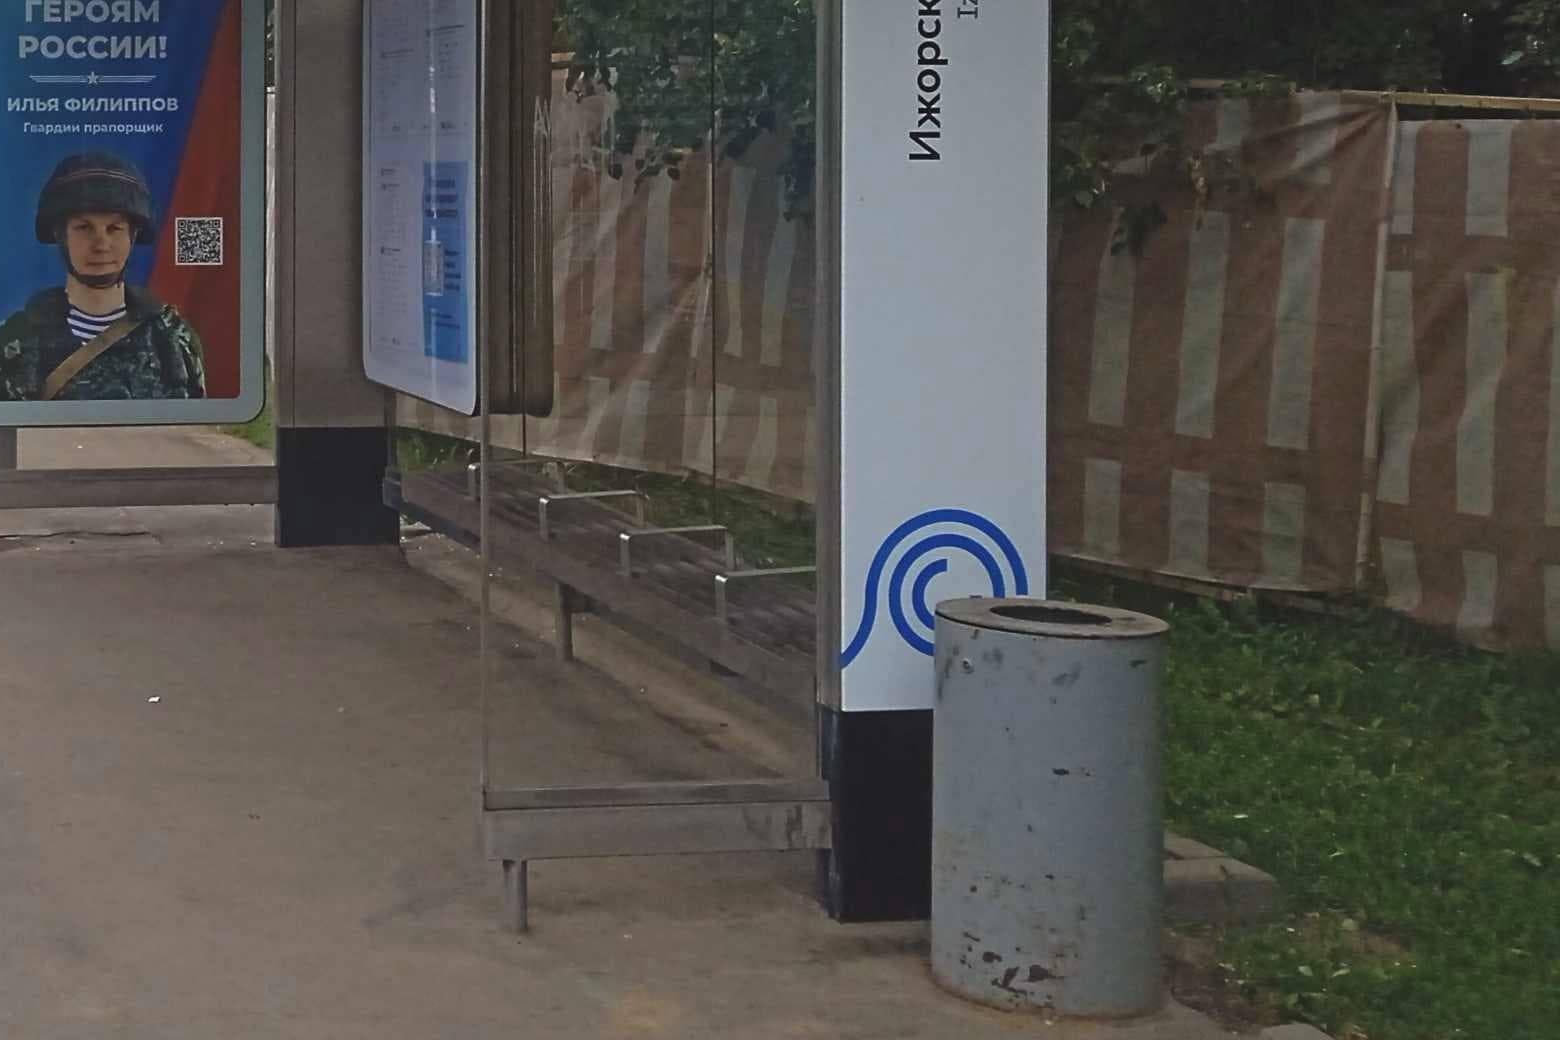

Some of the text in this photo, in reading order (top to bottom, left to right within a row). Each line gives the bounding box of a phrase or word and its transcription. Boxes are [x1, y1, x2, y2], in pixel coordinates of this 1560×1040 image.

[18, 34, 168, 59] РОССИИ!
[7, 96, 179, 112] ИЛЬЯ ФИЛИППОВ
[23, 121, 163, 137] Гвардии прапорщик
